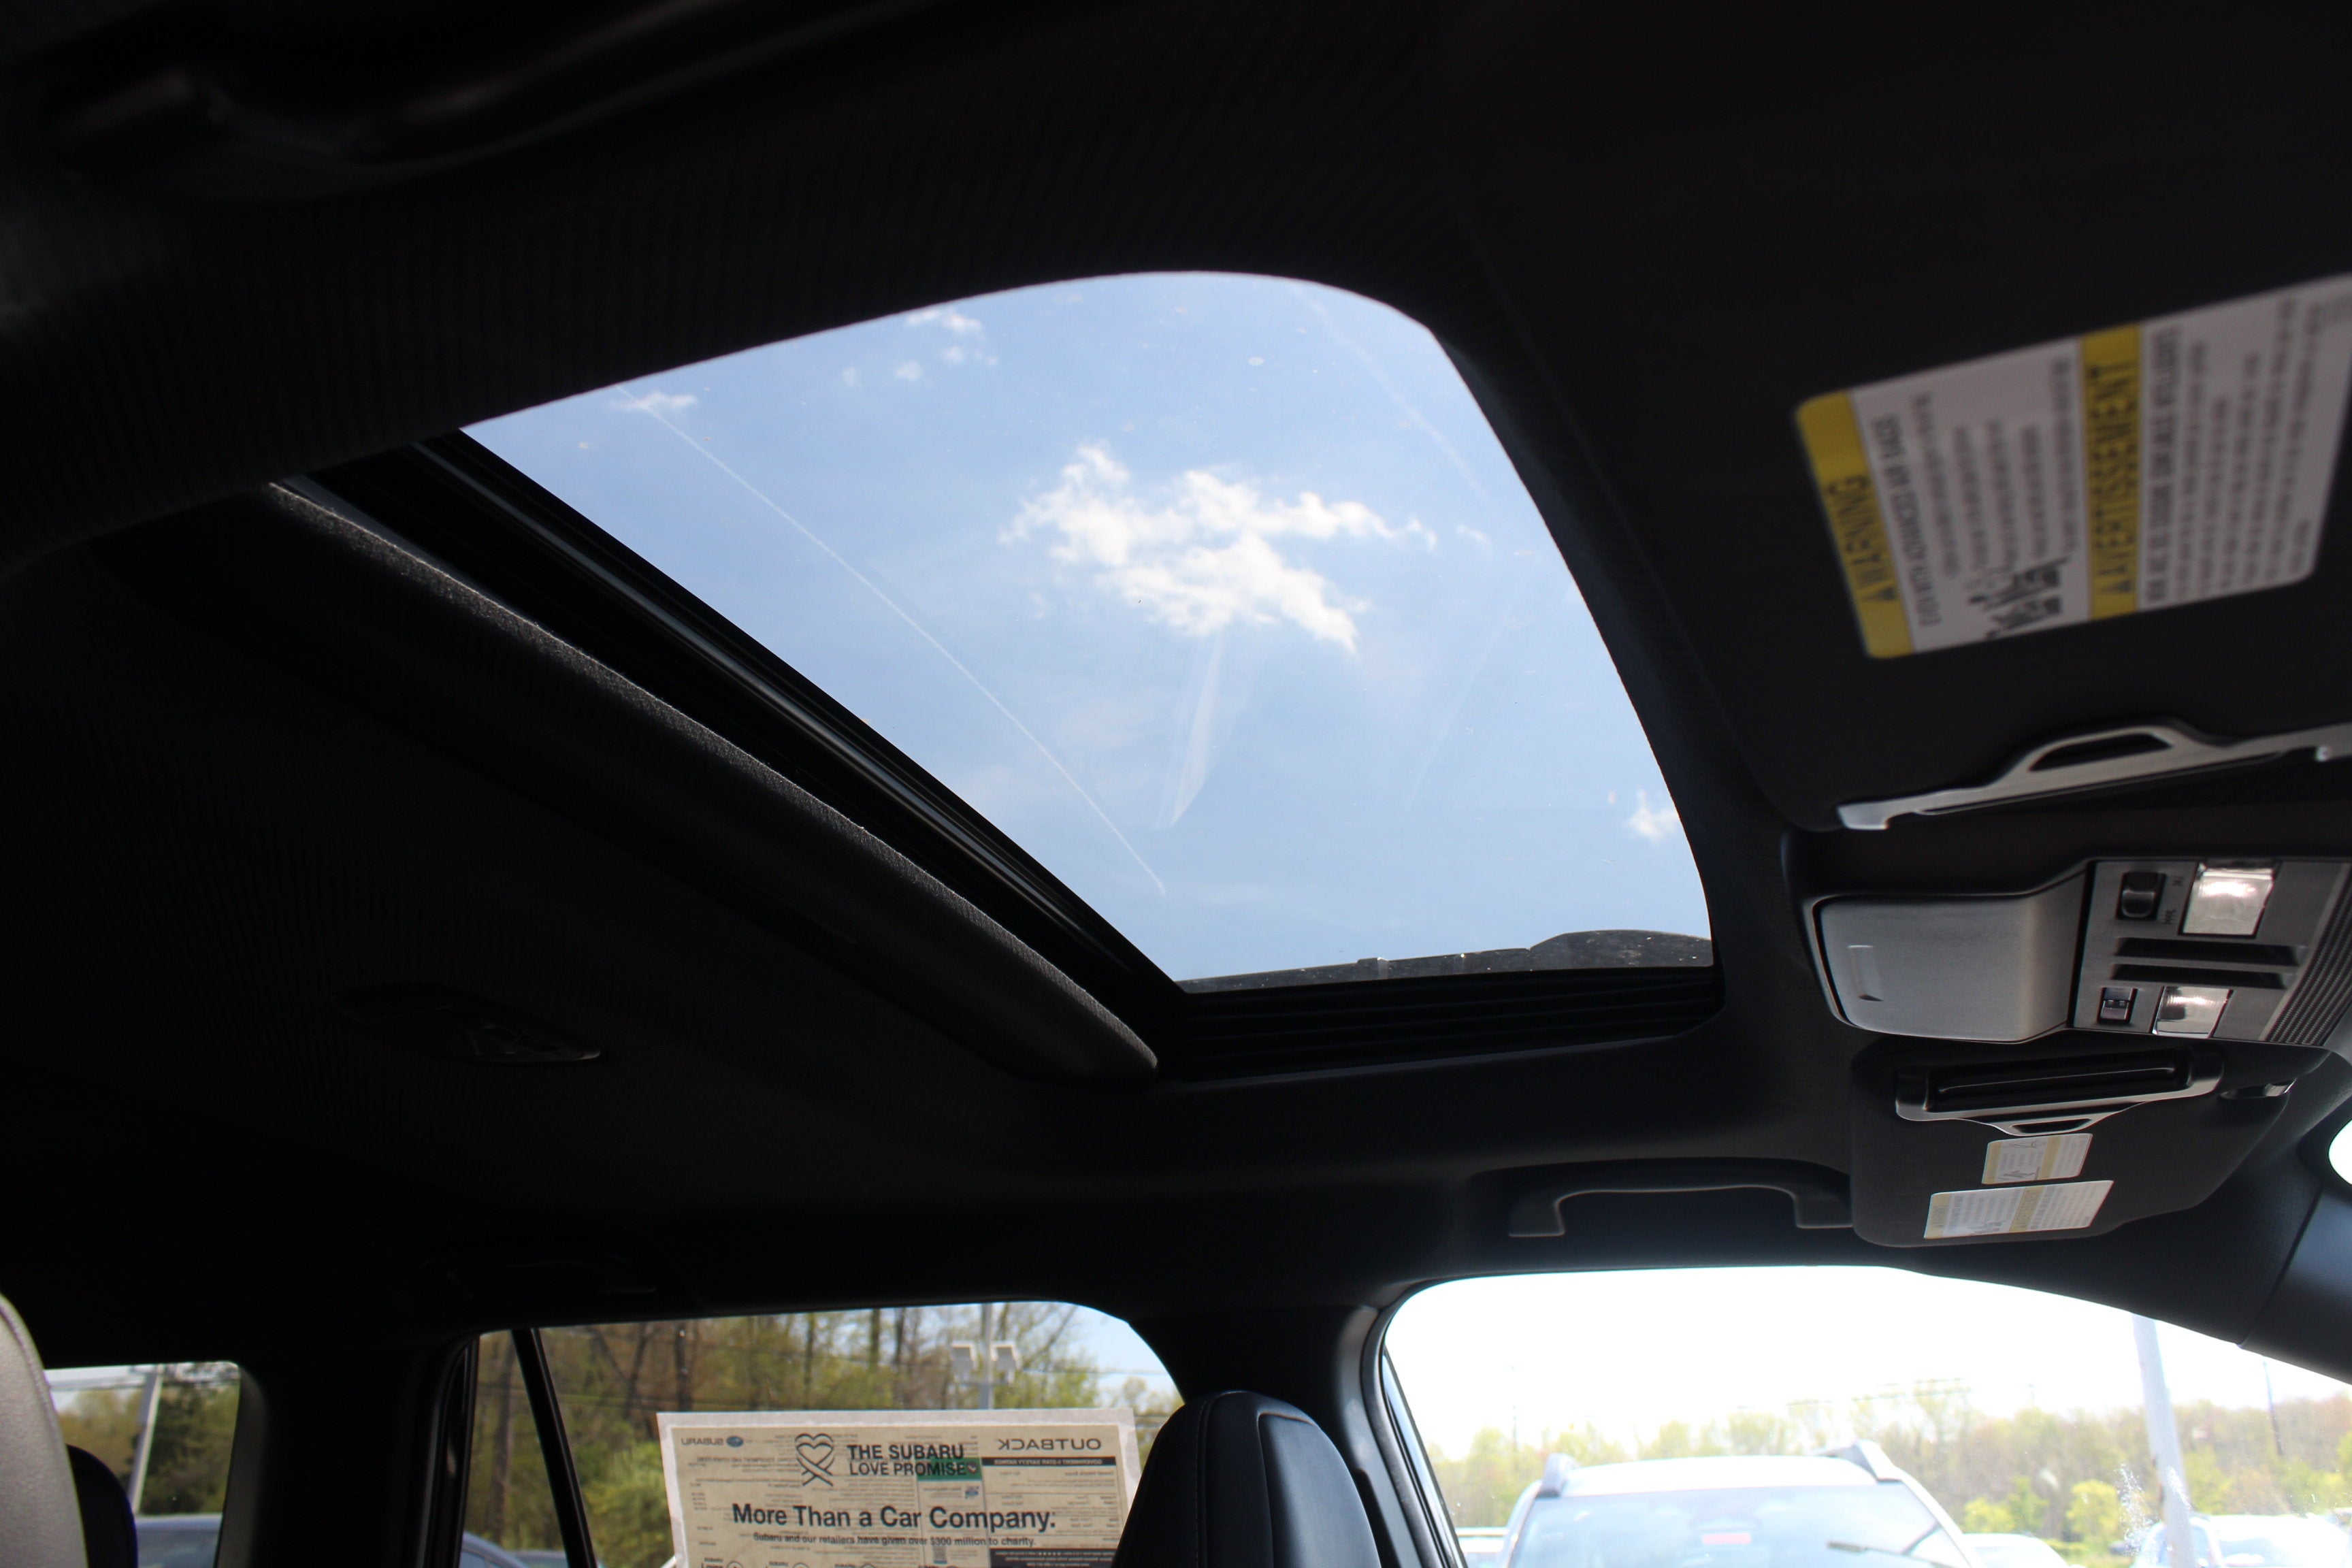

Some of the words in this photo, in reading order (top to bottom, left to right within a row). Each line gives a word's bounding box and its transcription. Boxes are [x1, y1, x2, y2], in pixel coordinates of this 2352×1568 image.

[1825, 474, 1889, 587] WARNING
[847, 1445, 883, 1460] THE
[889, 1444, 964, 1460] SUBARU
[850, 1463, 889, 1475] LOVE
[894, 1462, 966, 1476] PROMISE
[733, 1503, 787, 1525] More
[793, 1505, 851, 1526] Than
[860, 1512, 872, 1526] a
[880, 1505, 921, 1527] Car
[930, 1506, 1056, 1533] Company.
[753, 1533, 783, 1541] Subaru
[785, 1534, 800, 1542] and
[819, 1535, 855, 1544] retailers
[858, 1535, 879, 1544] have
[882, 1536, 906, 1546] given
[930, 1536, 951, 1546] $300
[955, 1537, 986, 1546] million
[989, 1537, 998, 1546] to
[1001, 1537, 1036, 1547] charity.
